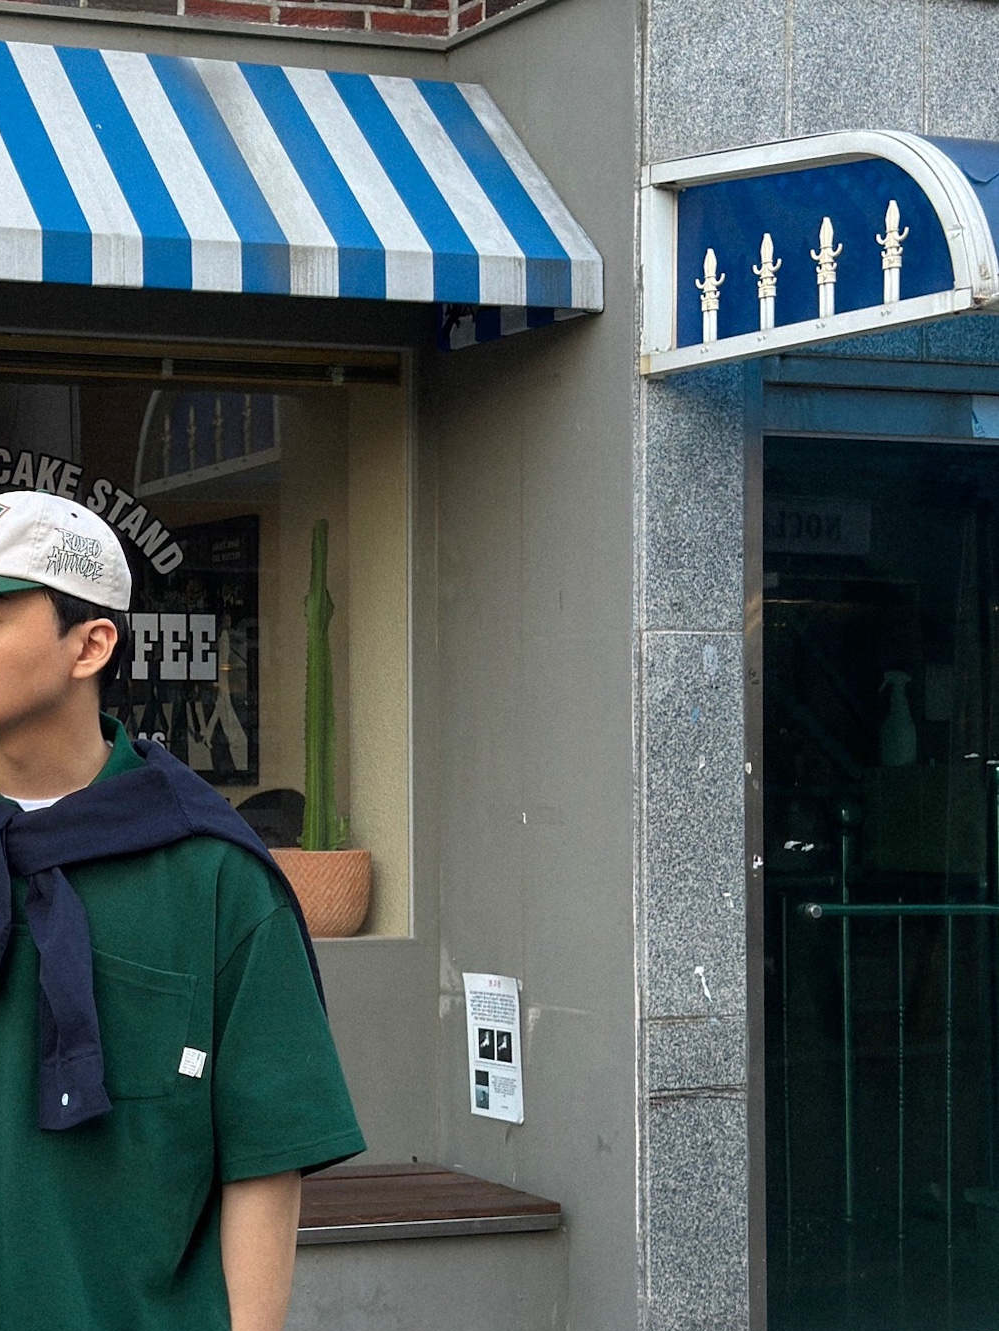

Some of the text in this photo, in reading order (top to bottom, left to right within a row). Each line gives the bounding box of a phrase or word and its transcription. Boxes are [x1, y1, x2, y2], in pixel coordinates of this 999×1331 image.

[54, 528, 102, 558] RODEO
[86, 479, 184, 575] STAND
[45, 546, 104, 582] ATTITUDE
[120, 613, 217, 680] FEE
